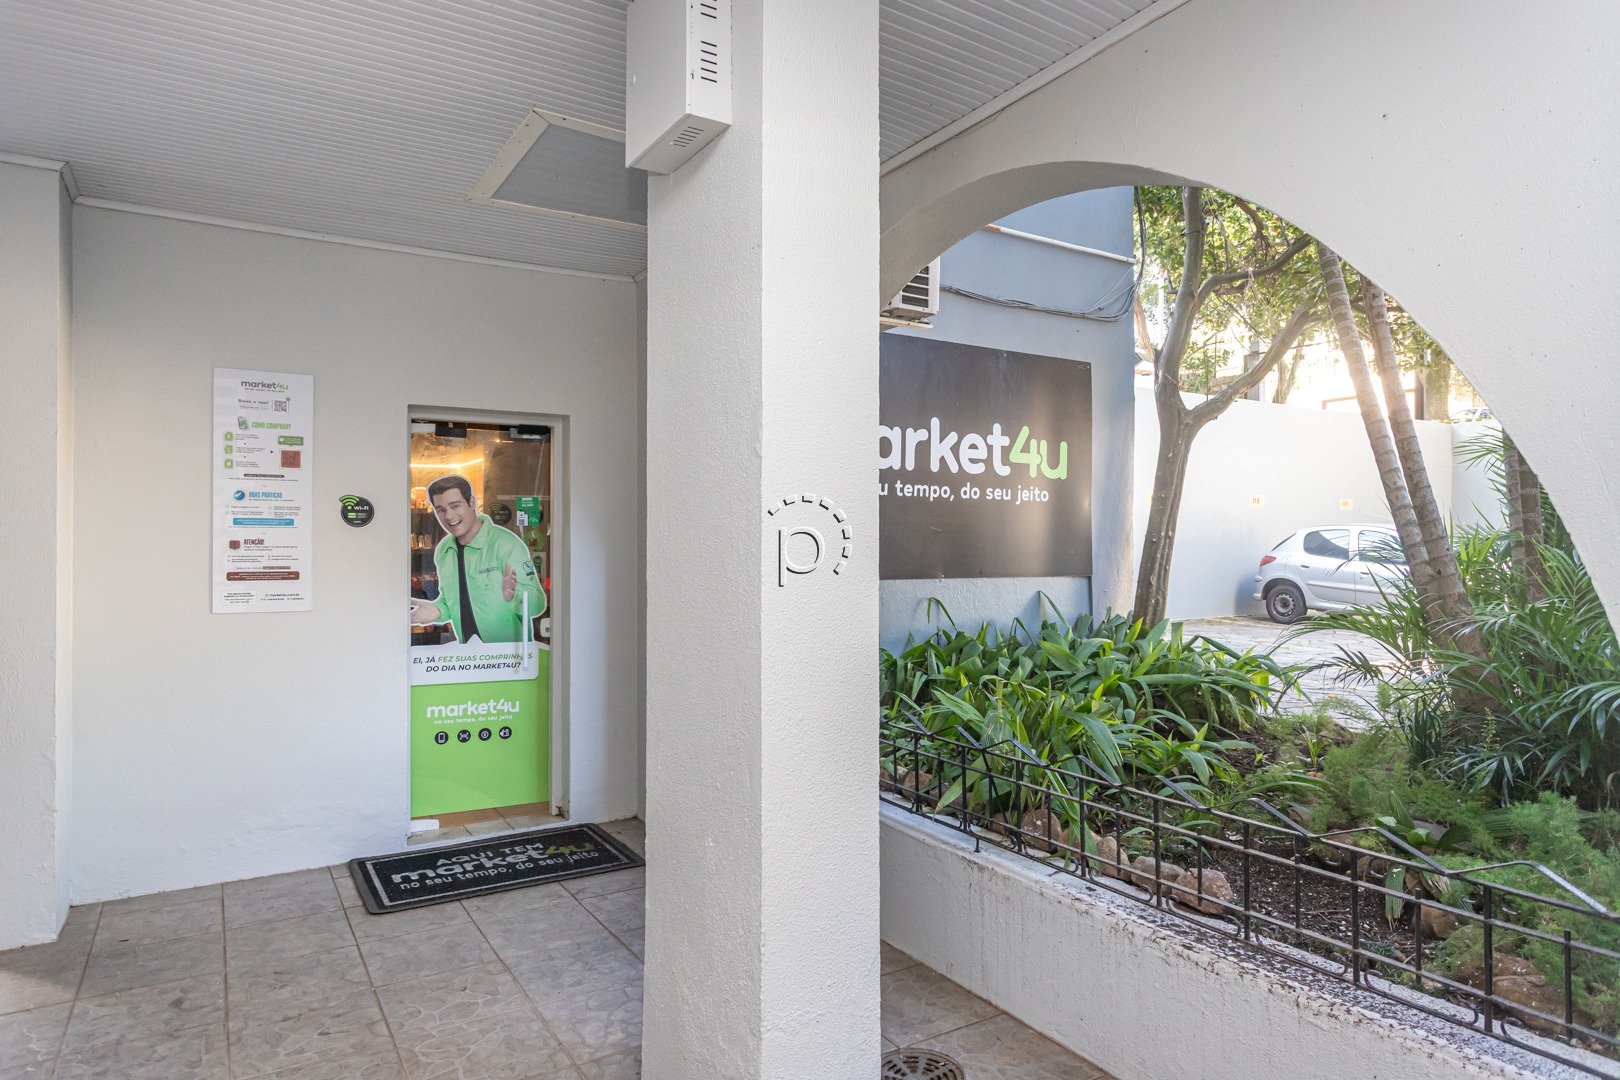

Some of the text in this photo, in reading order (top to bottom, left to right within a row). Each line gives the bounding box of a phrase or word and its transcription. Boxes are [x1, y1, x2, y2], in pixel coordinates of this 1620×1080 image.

[241, 381, 289, 390] market4u
[879, 417, 1068, 480] arket4u
[895, 480, 955, 502] tempo,
[960, 482, 981, 500] do
[986, 486, 1011, 501] seu
[1015, 485, 1049, 505] jeito
[413, 657, 423, 665] EI,
[425, 656, 436, 664] JÁ
[438, 655, 454, 663] FEZ
[456, 654, 477, 662] SUAS
[473, 662, 521, 670] MARKET4U?
[426, 698, 520, 719] market4u
[456, 717, 477, 725] tempo,
[437, 842, 545, 866] AQUI TEM
[400, 851, 600, 891] no seu tempo, do seu jeito
